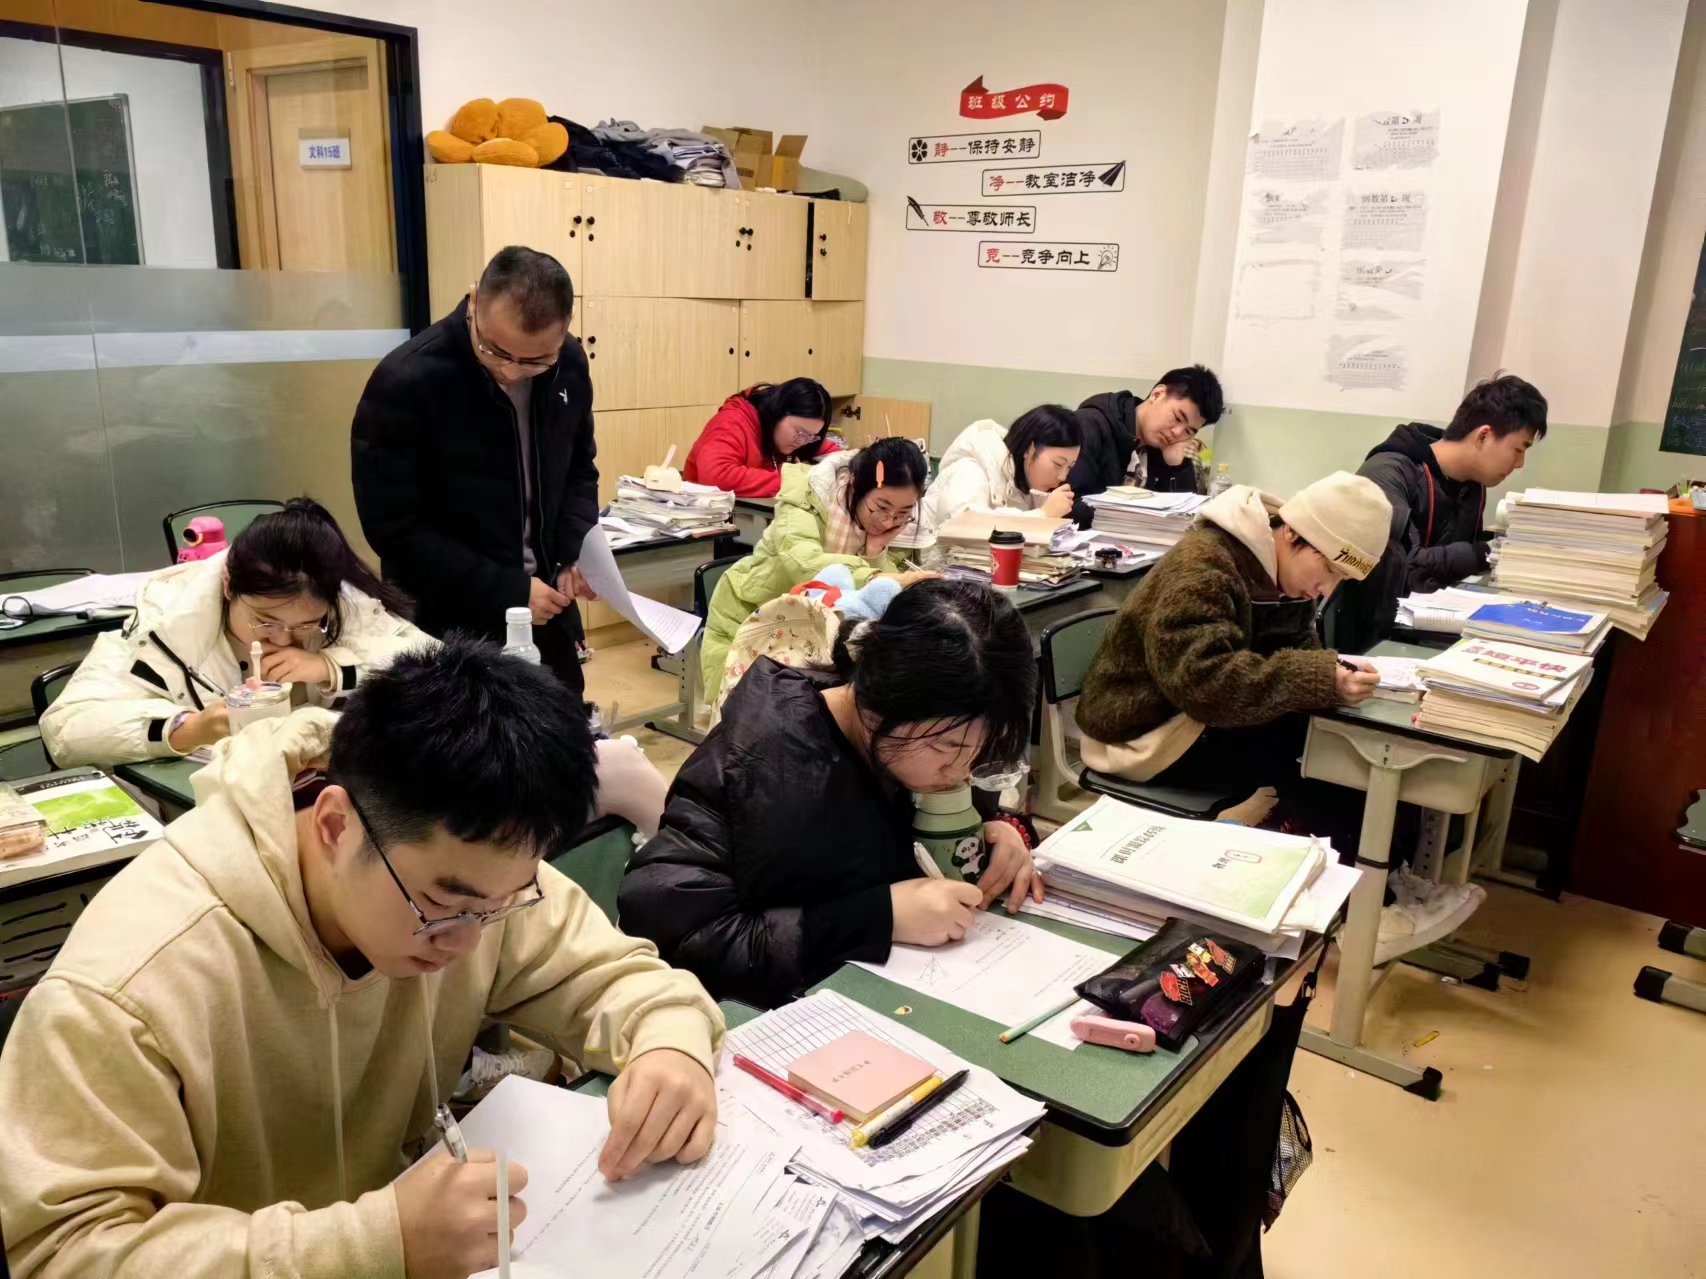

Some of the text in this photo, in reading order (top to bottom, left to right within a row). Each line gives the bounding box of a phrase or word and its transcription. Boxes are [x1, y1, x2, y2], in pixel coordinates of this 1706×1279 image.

[967, 93, 1056, 110] 班级公约
[308, 144, 341, 159] 文科15班
